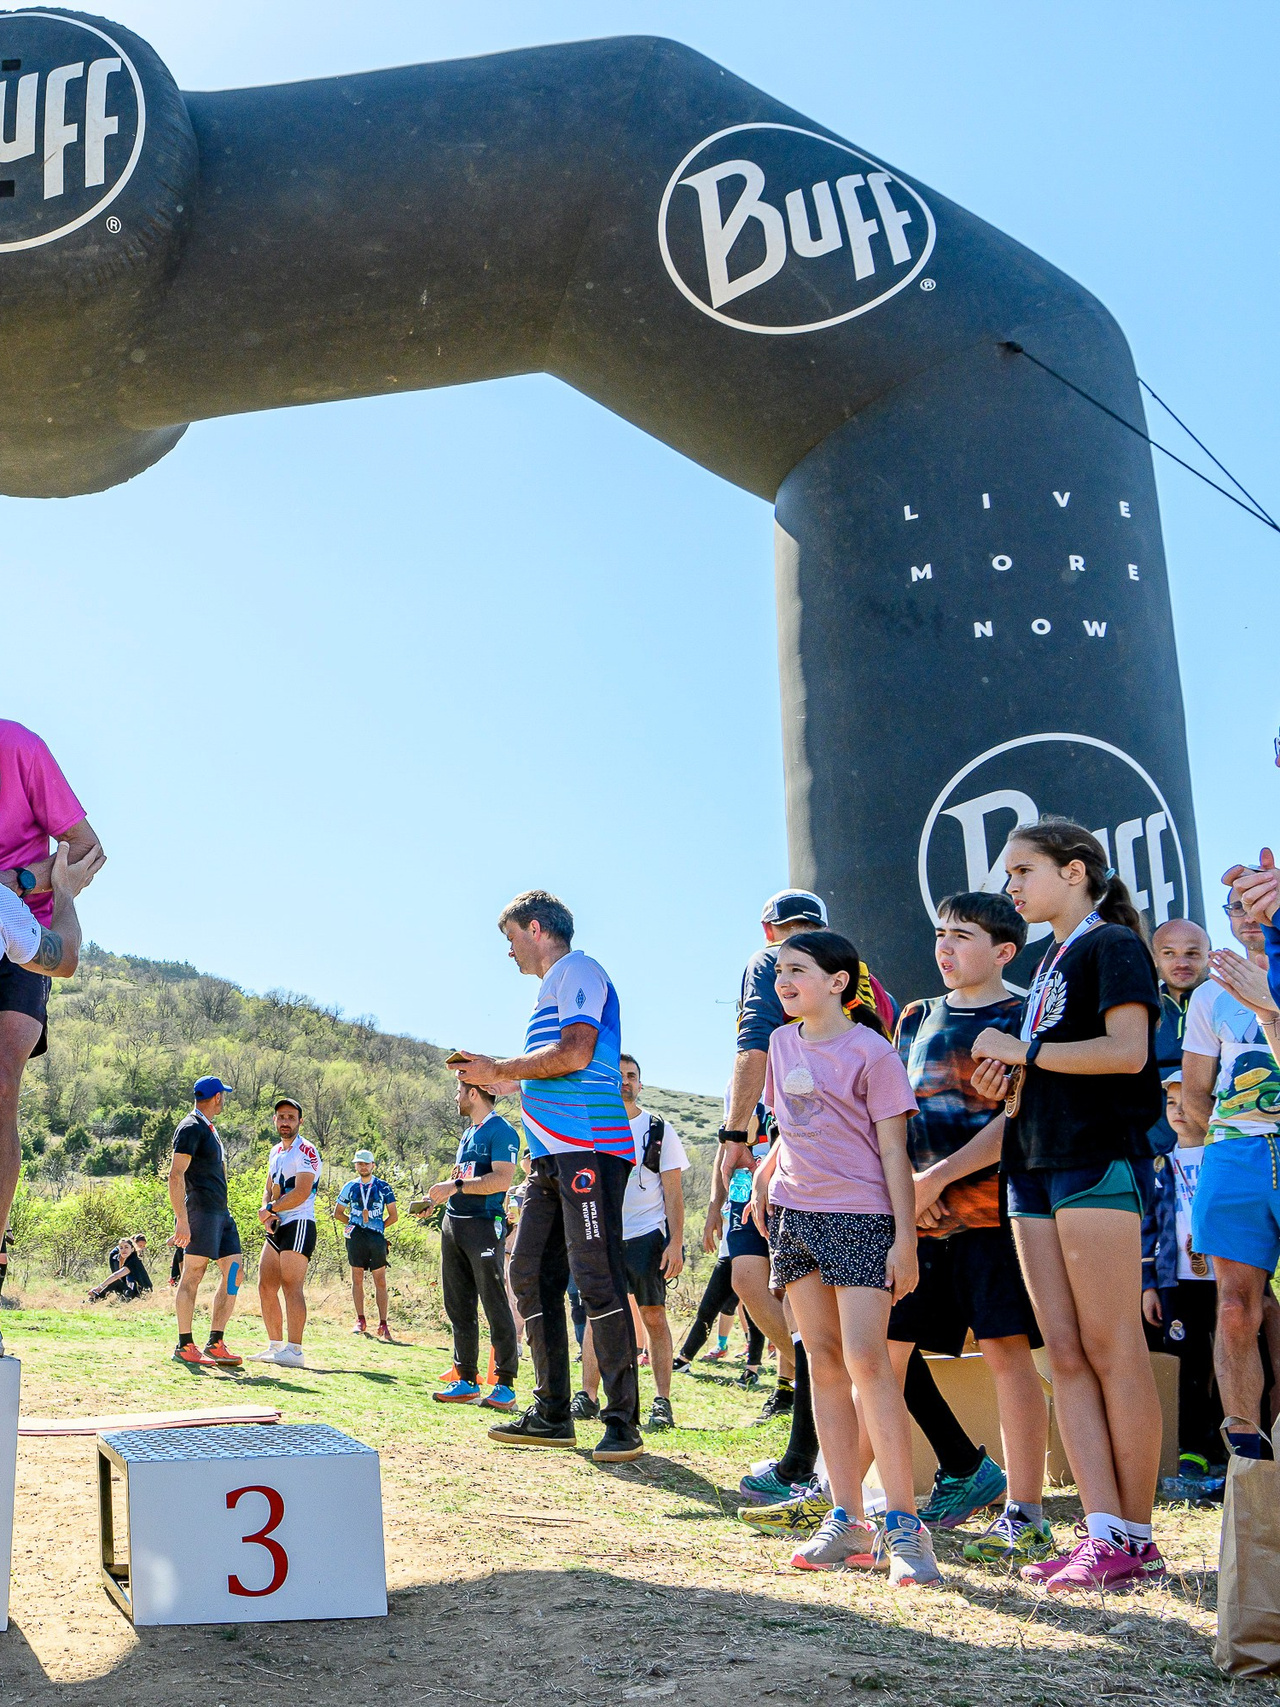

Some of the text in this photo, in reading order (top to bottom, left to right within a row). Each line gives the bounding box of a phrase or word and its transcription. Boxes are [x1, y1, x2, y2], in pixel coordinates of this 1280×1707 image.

[903, 491, 1131, 522] LIVE
[910, 554, 1140, 582] MORE
[973, 618, 1107, 638] NOW
[581, 1201, 593, 1240] BULGARIAN
[589, 1200, 598, 1220] TEAM
[973, 1460, 993, 1489] HOKA
[225, 1485, 289, 1597] 3
